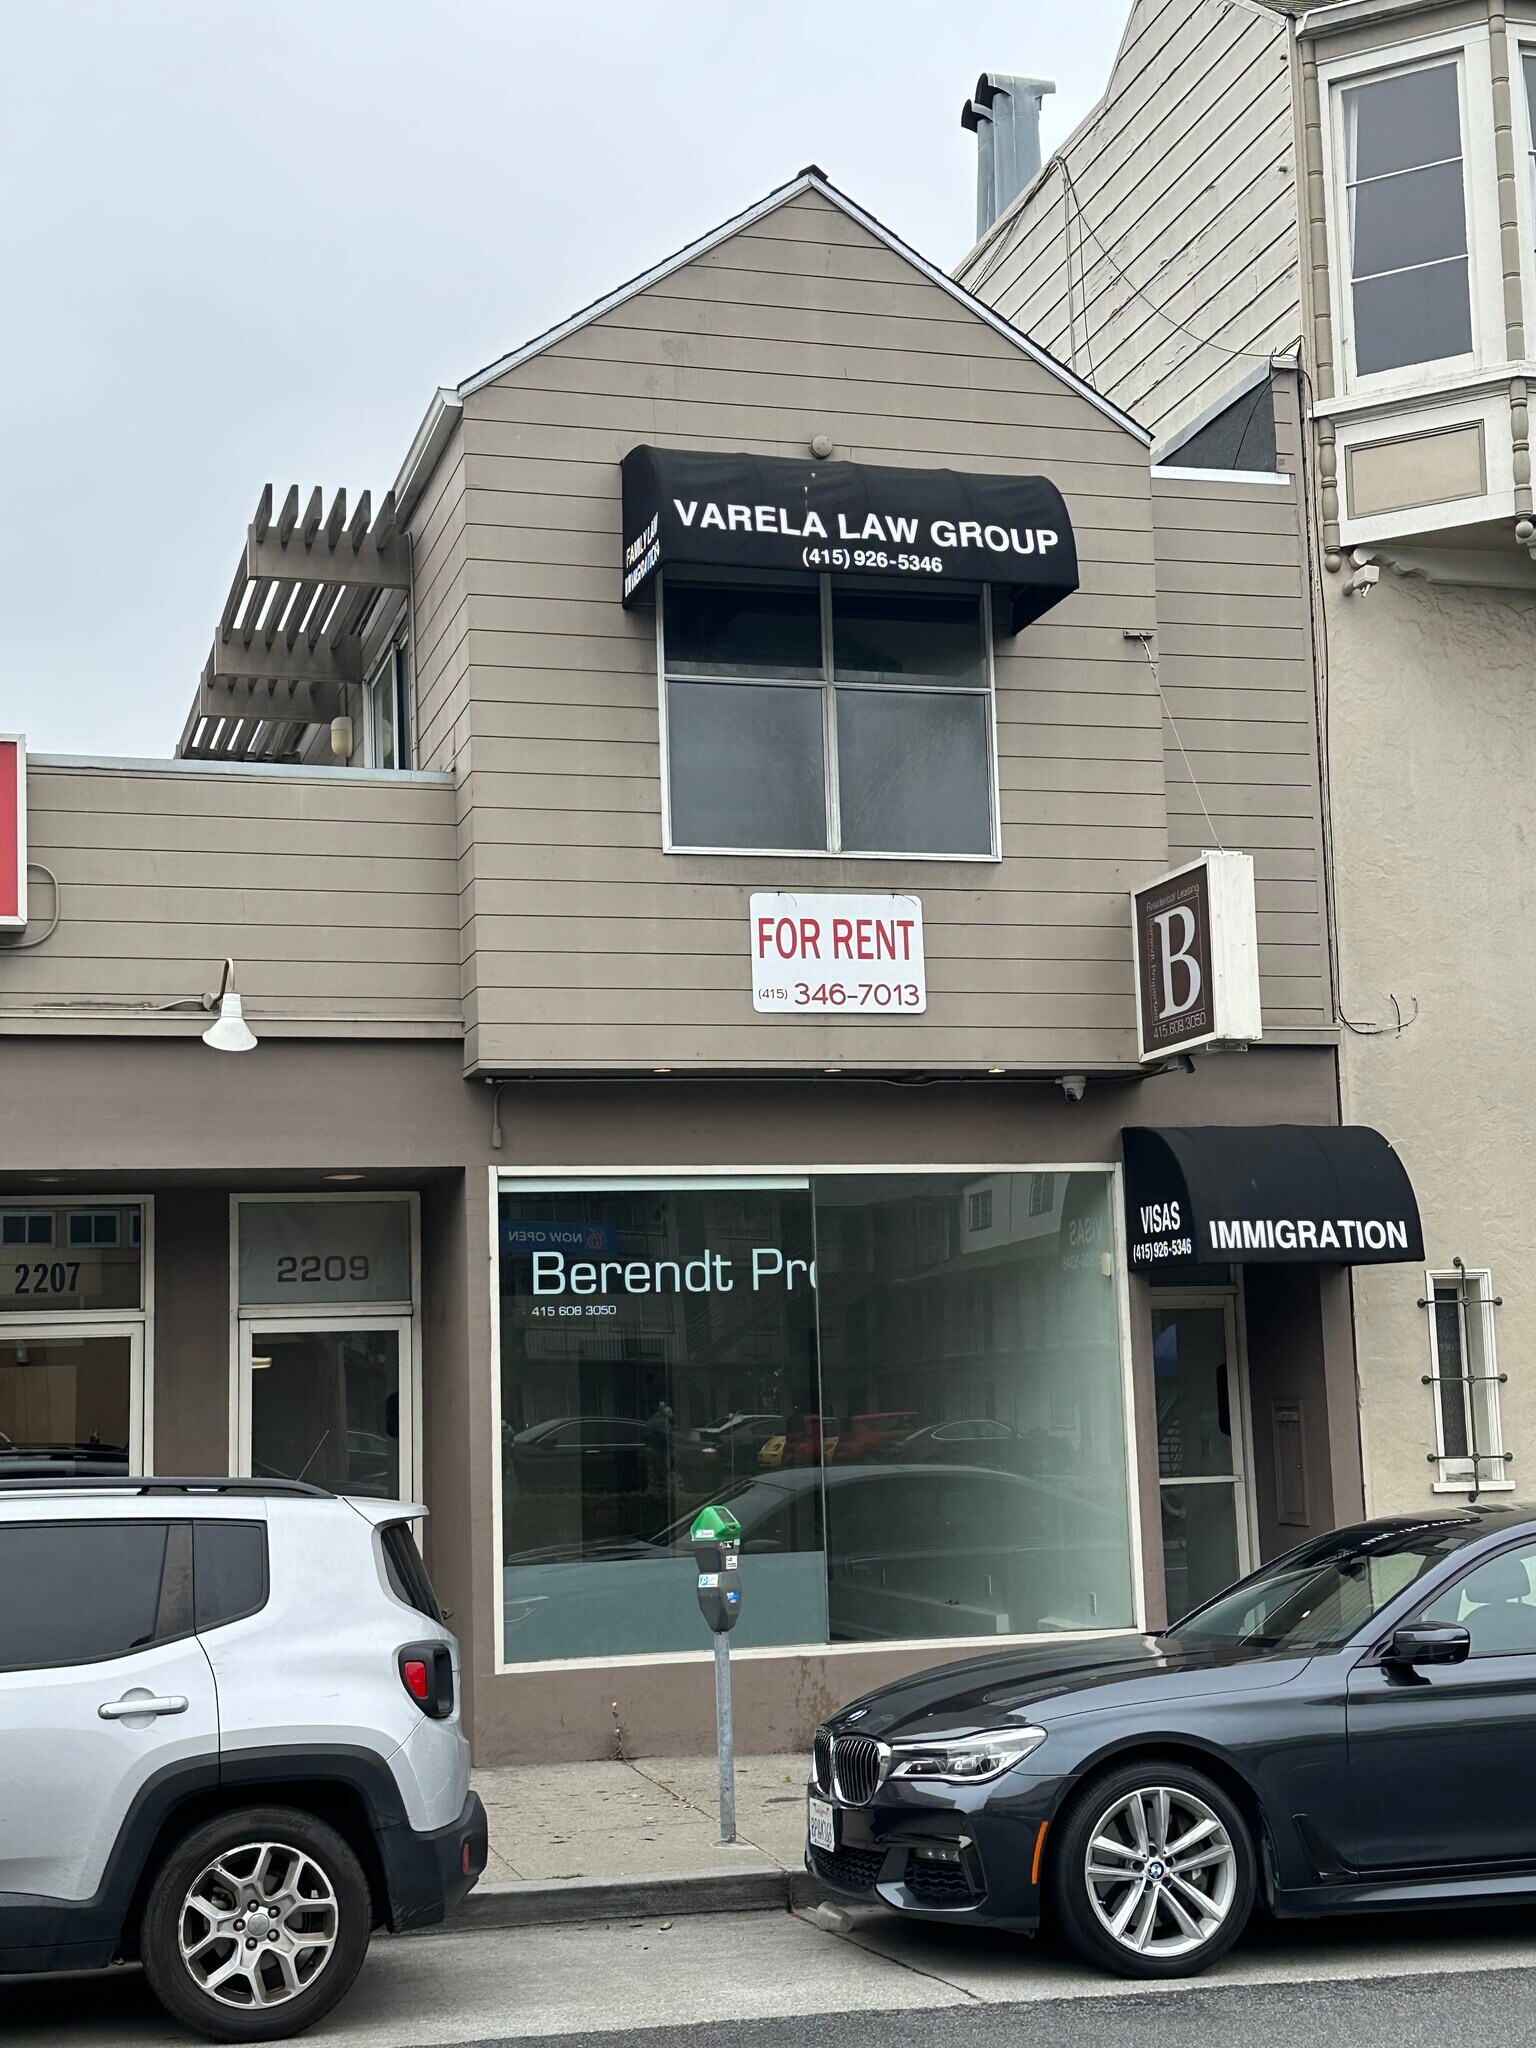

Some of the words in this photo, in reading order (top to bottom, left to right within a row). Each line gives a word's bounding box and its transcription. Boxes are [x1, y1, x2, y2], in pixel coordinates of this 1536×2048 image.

[673, 499, 827, 539] VARELA
[838, 513, 919, 544] LAW
[930, 520, 1059, 555] GROUP
[802, 546, 850, 569] (415)
[853, 549, 943, 573] 926-5346
[758, 917, 821, 960] FOR
[832, 918, 915, 961] RENT
[1154, 905, 1201, 1019] B
[758, 988, 788, 1000] (415)
[794, 982, 920, 1006] 346-7013
[1140, 1200, 1181, 1234] VISAS
[1208, 1220, 1409, 1249] IMMIGRATION
[1133, 1242, 1153, 1263] (415)
[1153, 1237, 1192, 1259] 926-5346
[14, 1262, 82, 1294] 2207
[277, 1255, 370, 1283] 2209
[532, 1249, 734, 1295] Berendt
[531, 1306, 555, 1317] 415
[558, 1306, 582, 1316] 608
[585, 1305, 617, 1316] 3050
